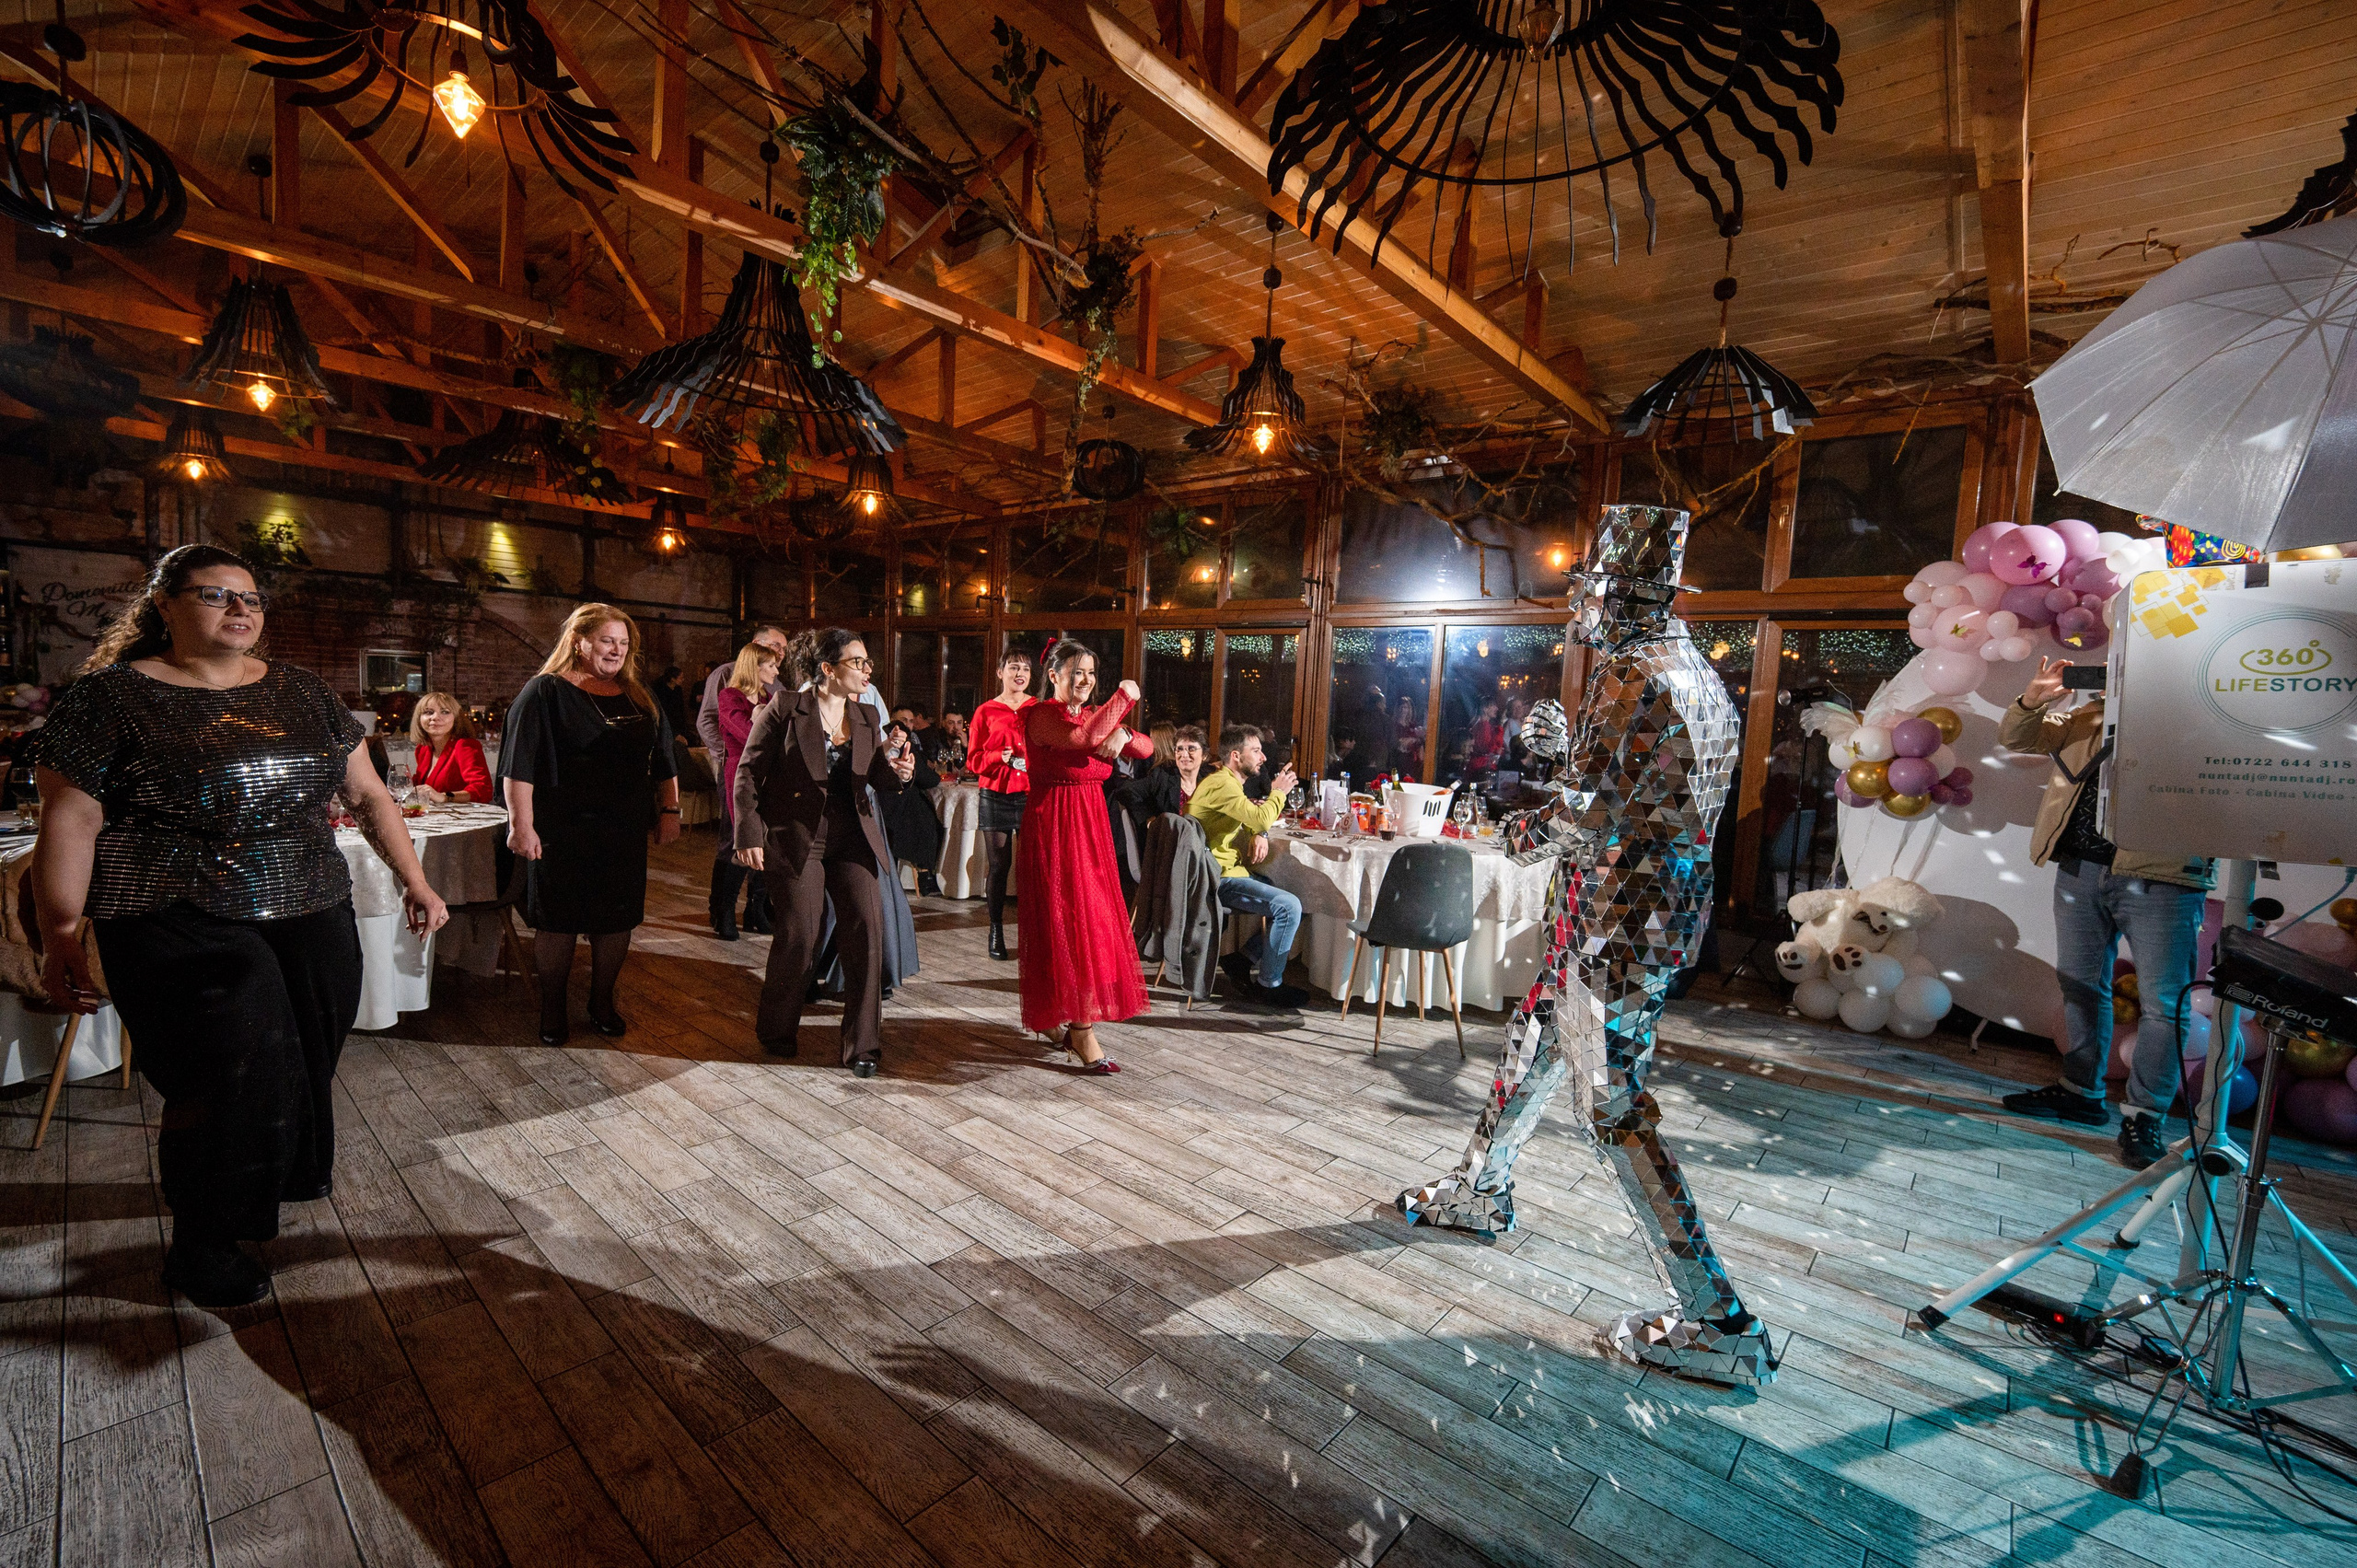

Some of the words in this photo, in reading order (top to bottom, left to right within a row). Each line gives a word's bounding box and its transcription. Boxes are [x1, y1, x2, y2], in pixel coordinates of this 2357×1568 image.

[2214, 678, 2357, 692] LIFESTORY
[2204, 756, 2272, 767] Tel:0722
[2281, 758, 2311, 768] 644
[2319, 760, 2352, 769] 318
[2198, 772, 2357, 785] nuntadj@nuntadj.ro
[2148, 784, 2194, 795] Cabina
[2200, 785, 2229, 796] Foto
[2247, 788, 2296, 798] Cabina
[2303, 790, 2345, 800] Video
[1343, 816, 1350, 826] 6
[2251, 993, 2329, 1029] Roland
